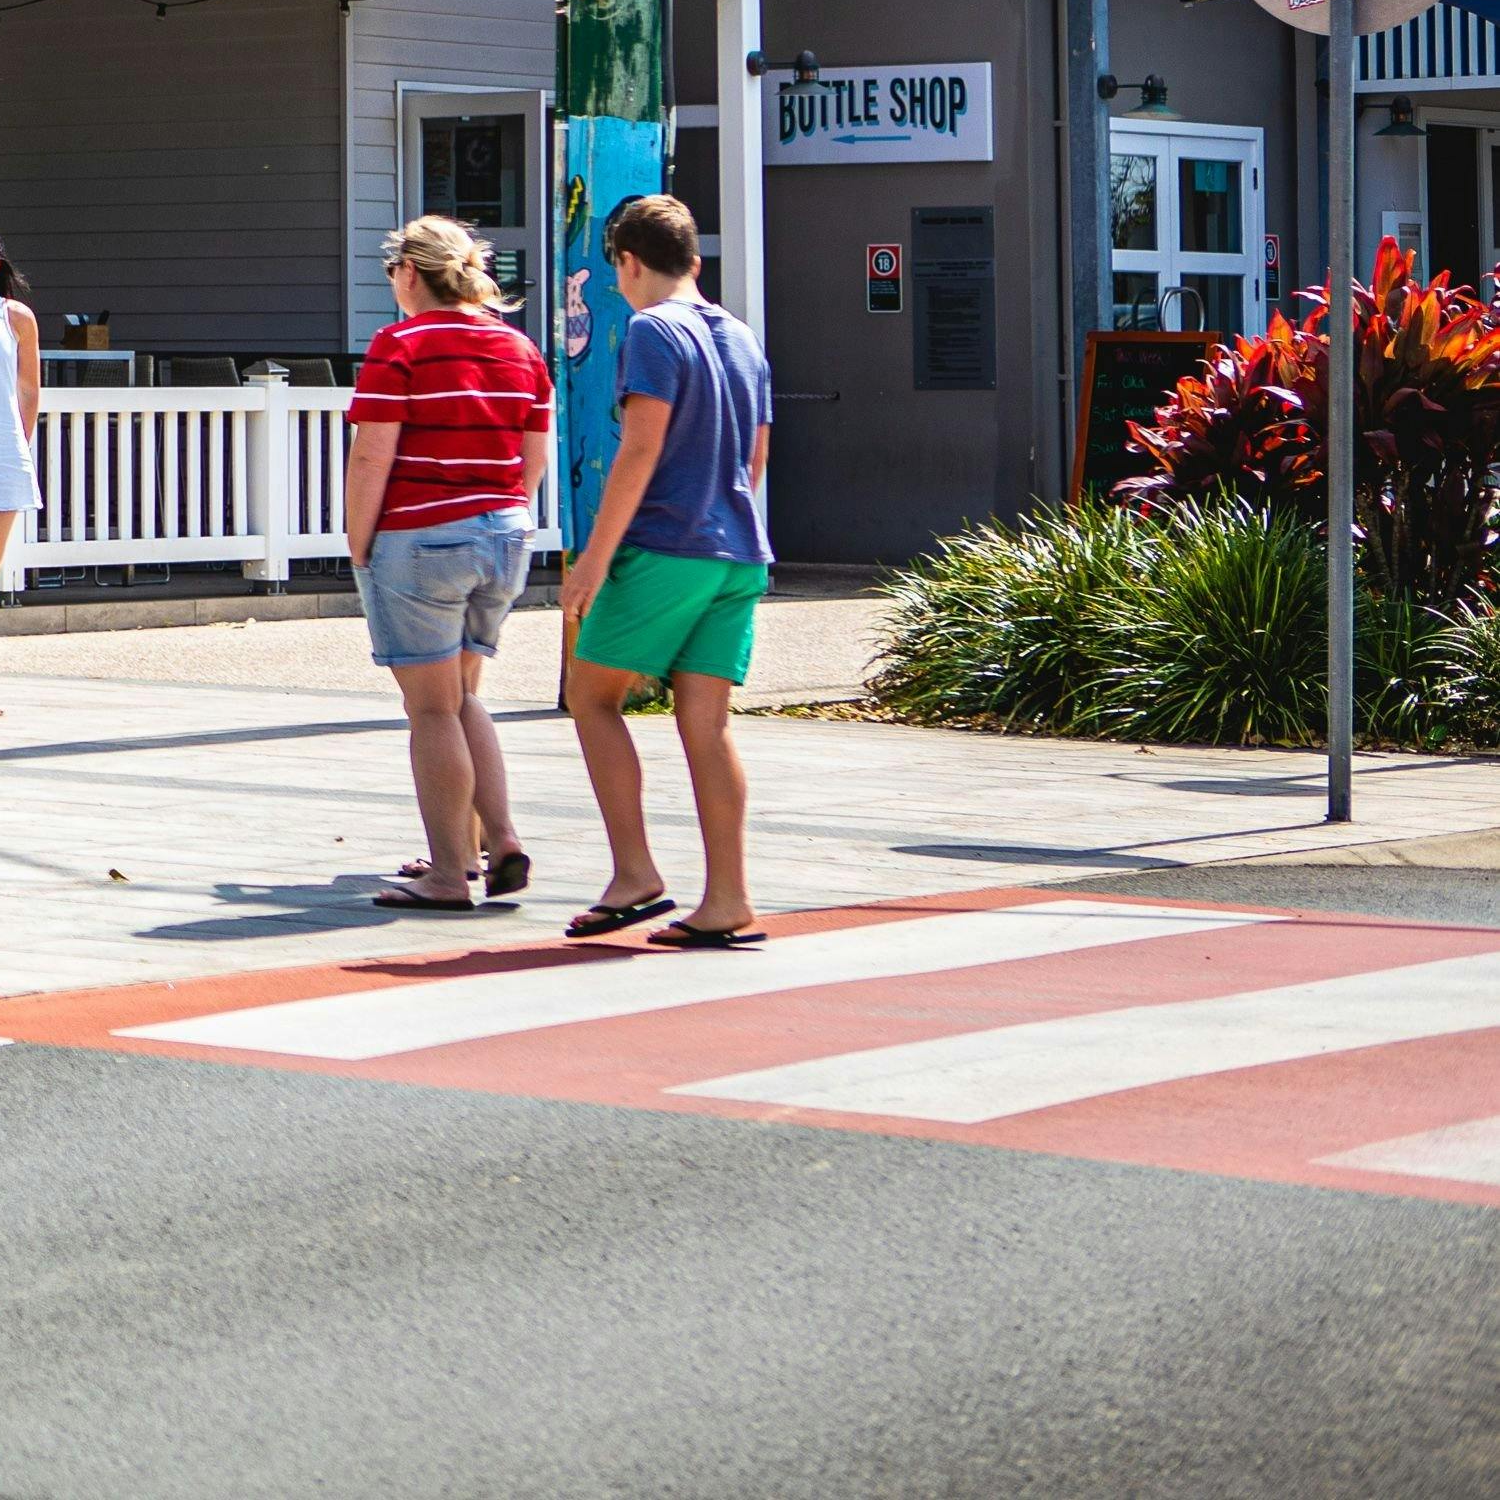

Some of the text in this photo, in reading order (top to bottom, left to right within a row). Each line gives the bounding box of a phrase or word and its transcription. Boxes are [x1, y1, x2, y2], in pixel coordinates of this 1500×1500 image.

[779, 76, 967, 143] BOTTLE SHOP
[877, 258, 890, 271] 18
